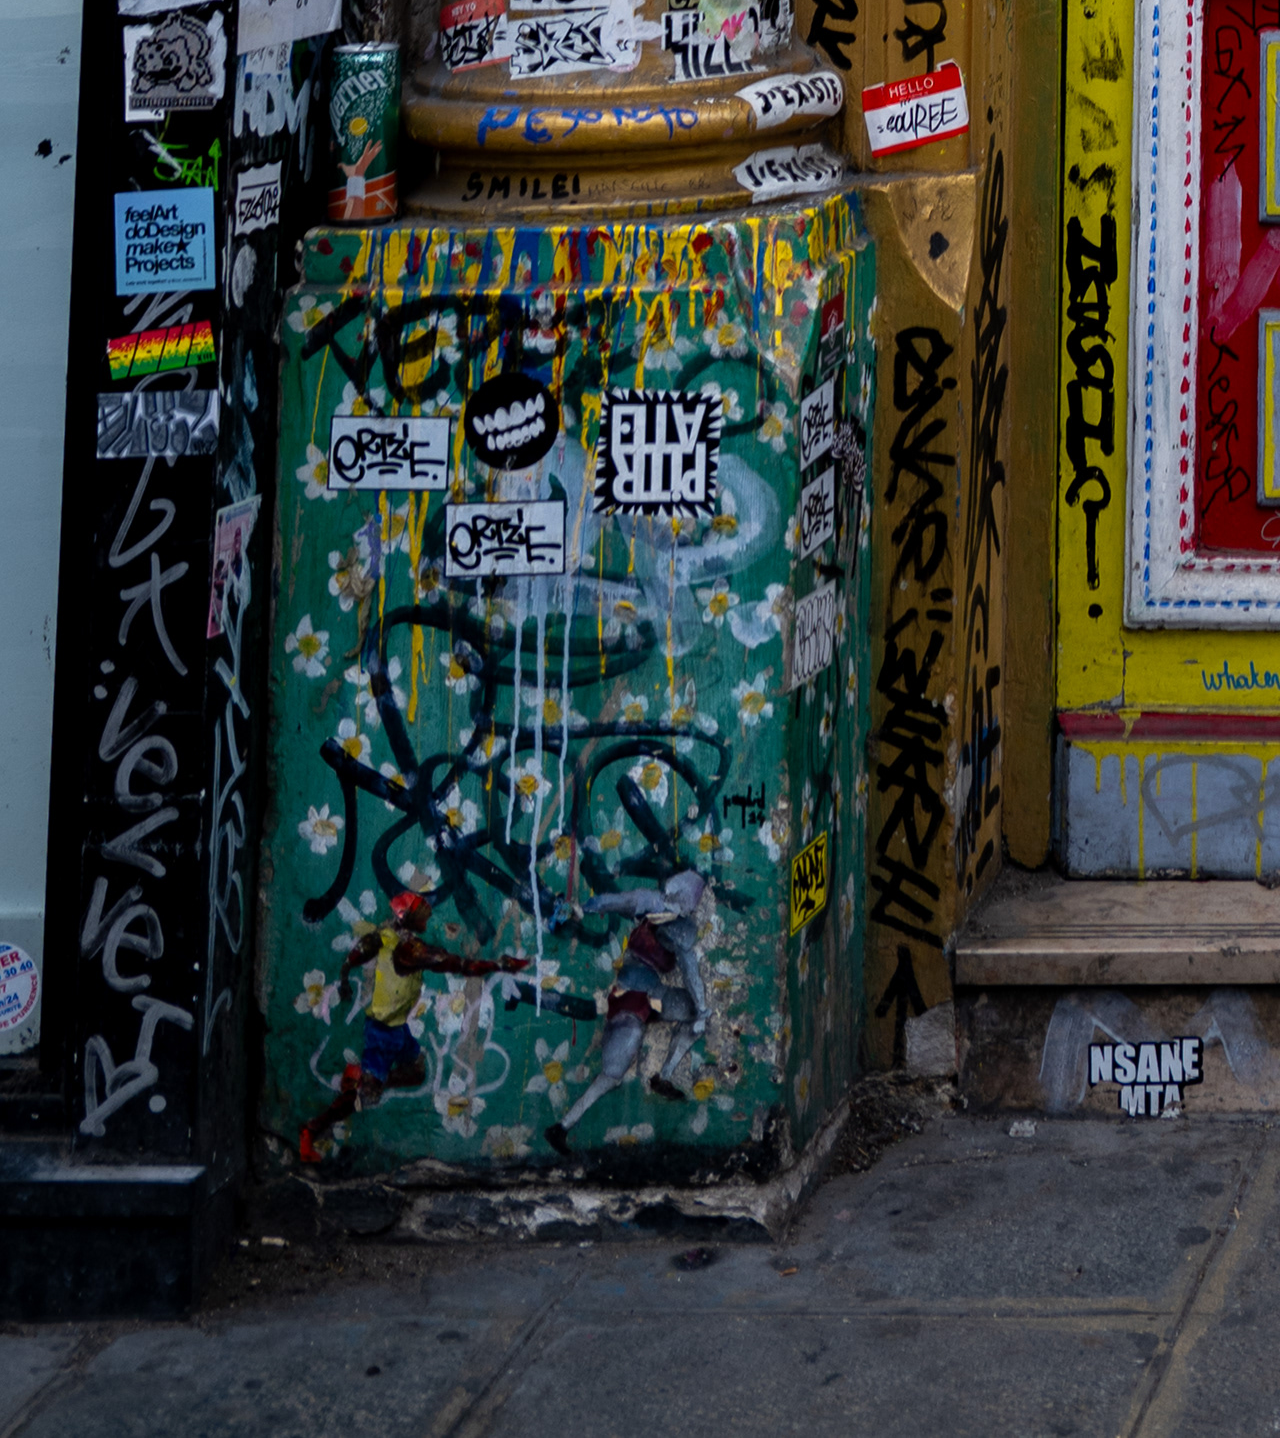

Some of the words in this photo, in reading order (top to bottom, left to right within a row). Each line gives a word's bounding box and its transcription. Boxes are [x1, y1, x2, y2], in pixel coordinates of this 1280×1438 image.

[888, 76, 934, 100] HELLO
[125, 220, 206, 240] doDesign
[126, 254, 196, 276] Projects
[1089, 1037, 1203, 1086] NSANE
[1120, 1081, 1182, 1117] MTA
